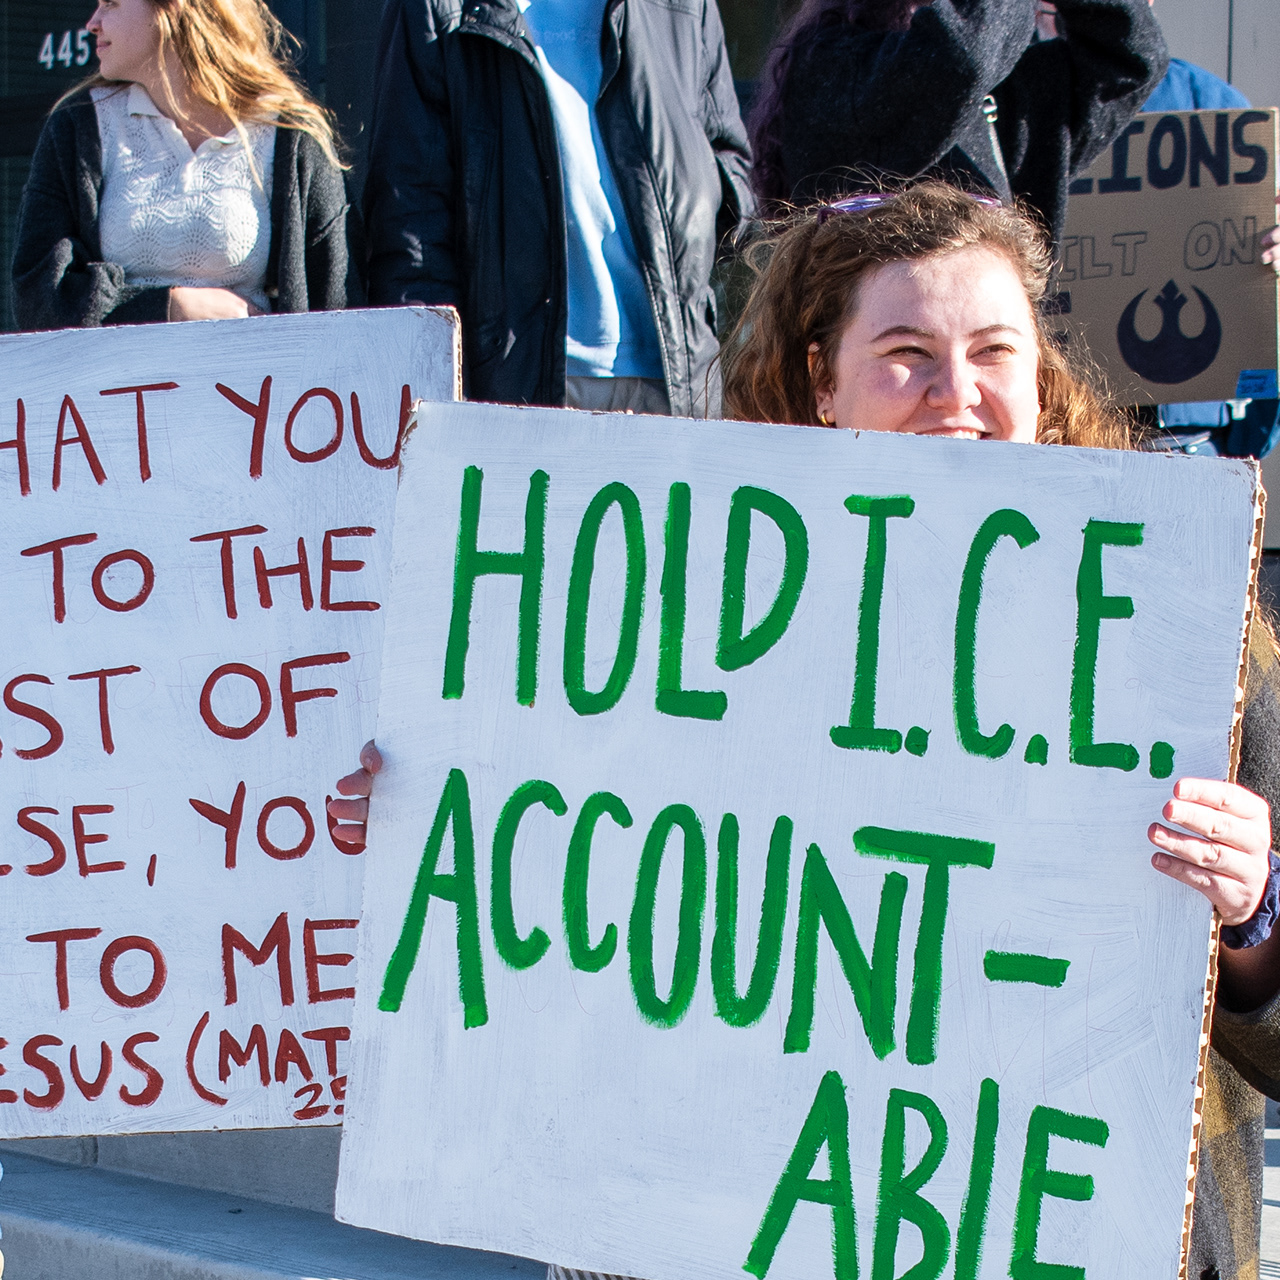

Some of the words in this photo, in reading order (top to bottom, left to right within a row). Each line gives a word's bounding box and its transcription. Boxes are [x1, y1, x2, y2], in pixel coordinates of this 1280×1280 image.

[38, 29, 90, 70] 445
[1069, 111, 1270, 195] IONS
[1184, 216, 1257, 271] ON
[216, 376, 411, 477] YOU
[21, 533, 154, 623] TO
[191, 525, 380, 619] THE
[442, 465, 808, 721] HOLD
[830, 494, 1175, 779] I.C.E.
[200, 652, 350, 740] OF
[189, 780, 368, 869] YOU
[26, 927, 167, 1010] TO
[222, 911, 360, 1006] ME
[378, 768, 1071, 1065] ACCOUNT-
